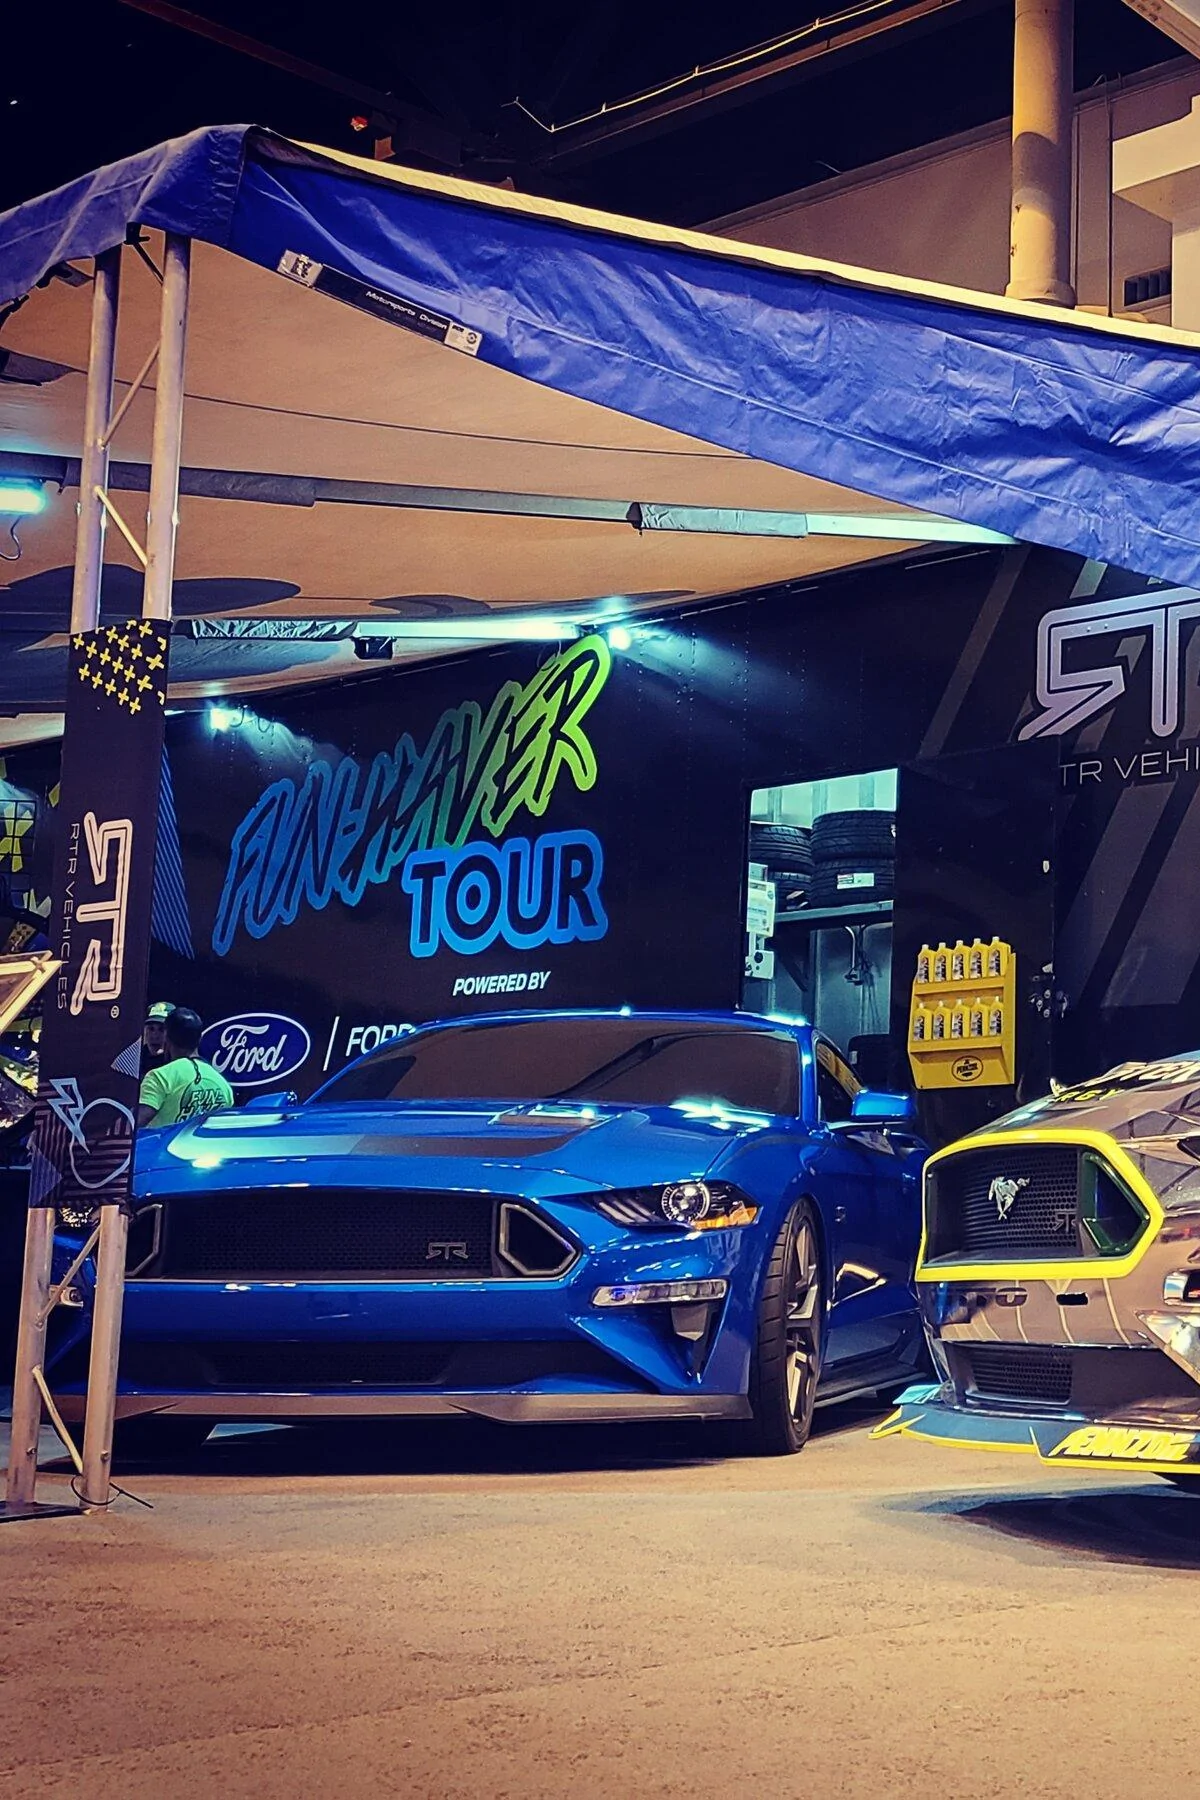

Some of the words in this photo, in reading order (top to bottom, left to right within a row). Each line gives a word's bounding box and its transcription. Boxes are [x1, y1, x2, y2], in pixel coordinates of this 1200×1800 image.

[366, 291, 416, 316] Motorsports
[1060, 760, 1102, 786] TR
[67, 822, 80, 874] RTR
[404, 831, 607, 956] TOUR
[57, 881, 77, 1010] VEHICLES
[452, 972, 528, 996] POWERED
[528, 971, 551, 991] BY
[212, 1024, 287, 1074] Ford
